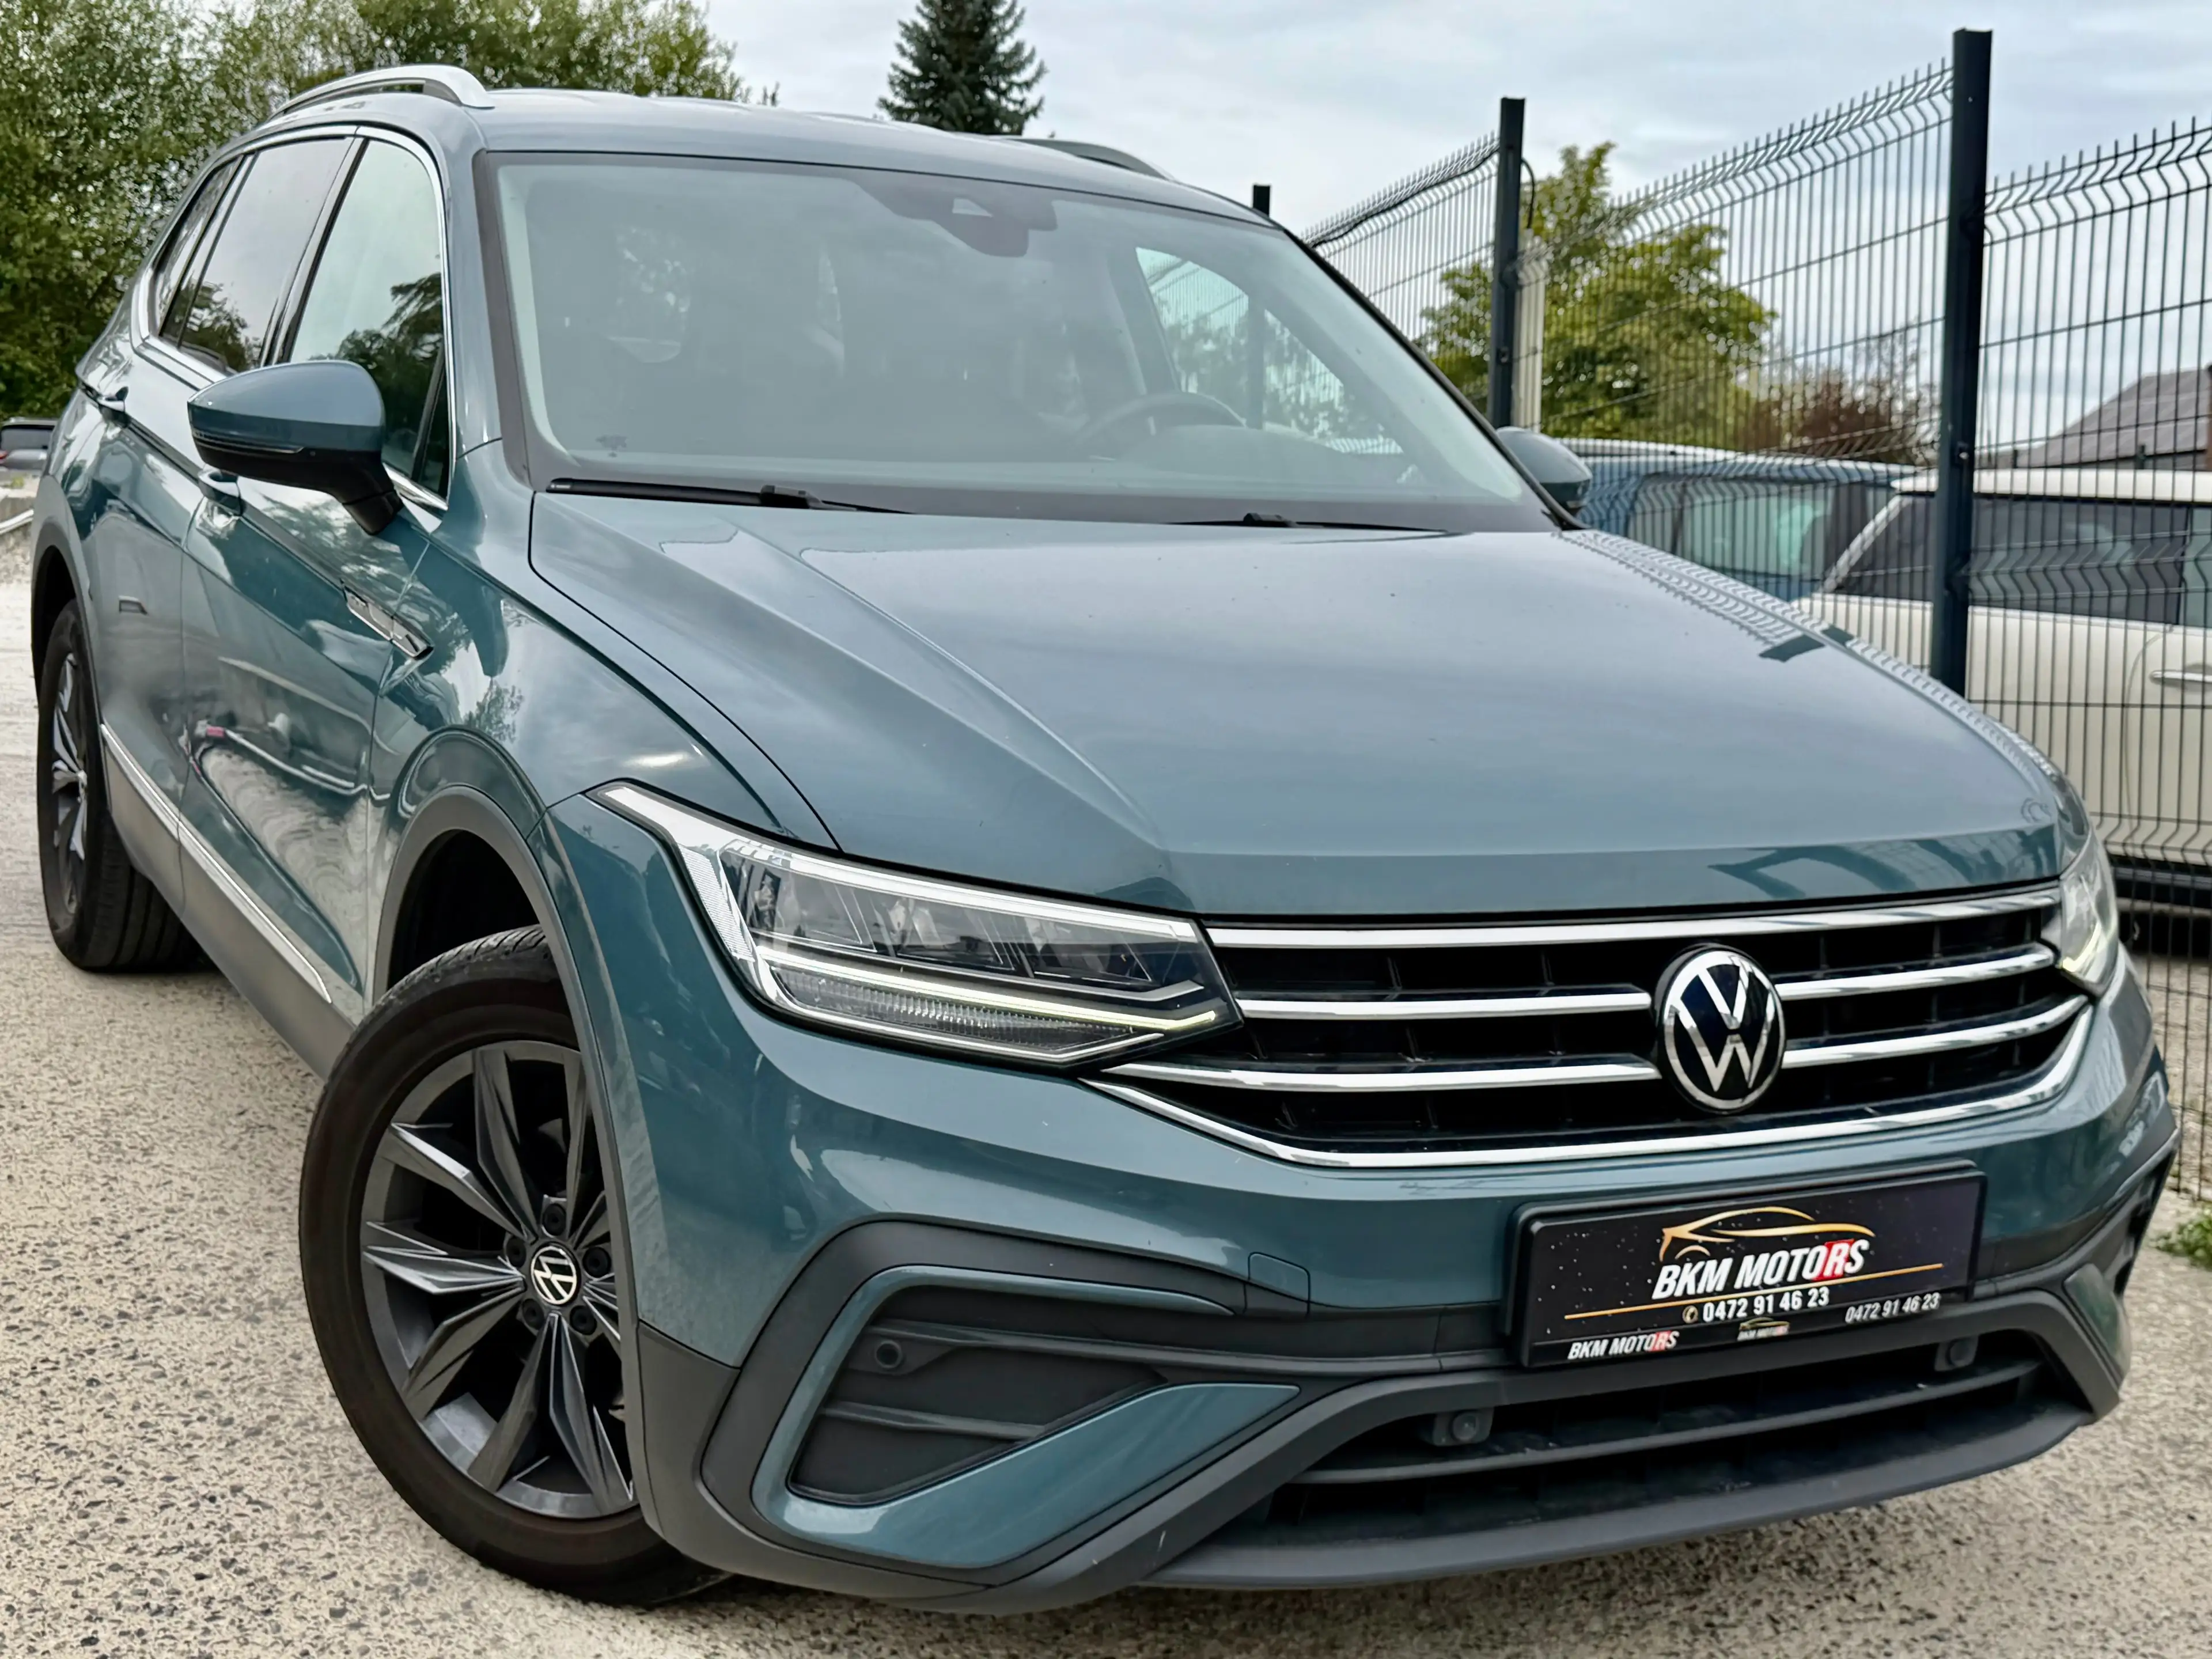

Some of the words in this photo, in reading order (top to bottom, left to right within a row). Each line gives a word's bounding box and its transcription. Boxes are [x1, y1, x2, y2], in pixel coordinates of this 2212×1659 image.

[1664, 950, 1778, 1101] VW
[1651, 1257, 1733, 1300] BKM
[1734, 1238, 1870, 1290] MOTORS
[1703, 1297, 1748, 1323] 0472
[1753, 1293, 1774, 1316] 91
[1779, 1290, 1803, 1312] 46
[1807, 1286, 1830, 1307] 23
[1844, 1302, 1881, 1324] 0472
[1881, 1298, 1901, 1319] 91
[1902, 1295, 1922, 1314] 46
[1921, 1291, 1942, 1311] 23
[1567, 1340, 1611, 1360] BKM
[1609, 1330, 1680, 1356] MOTORS
